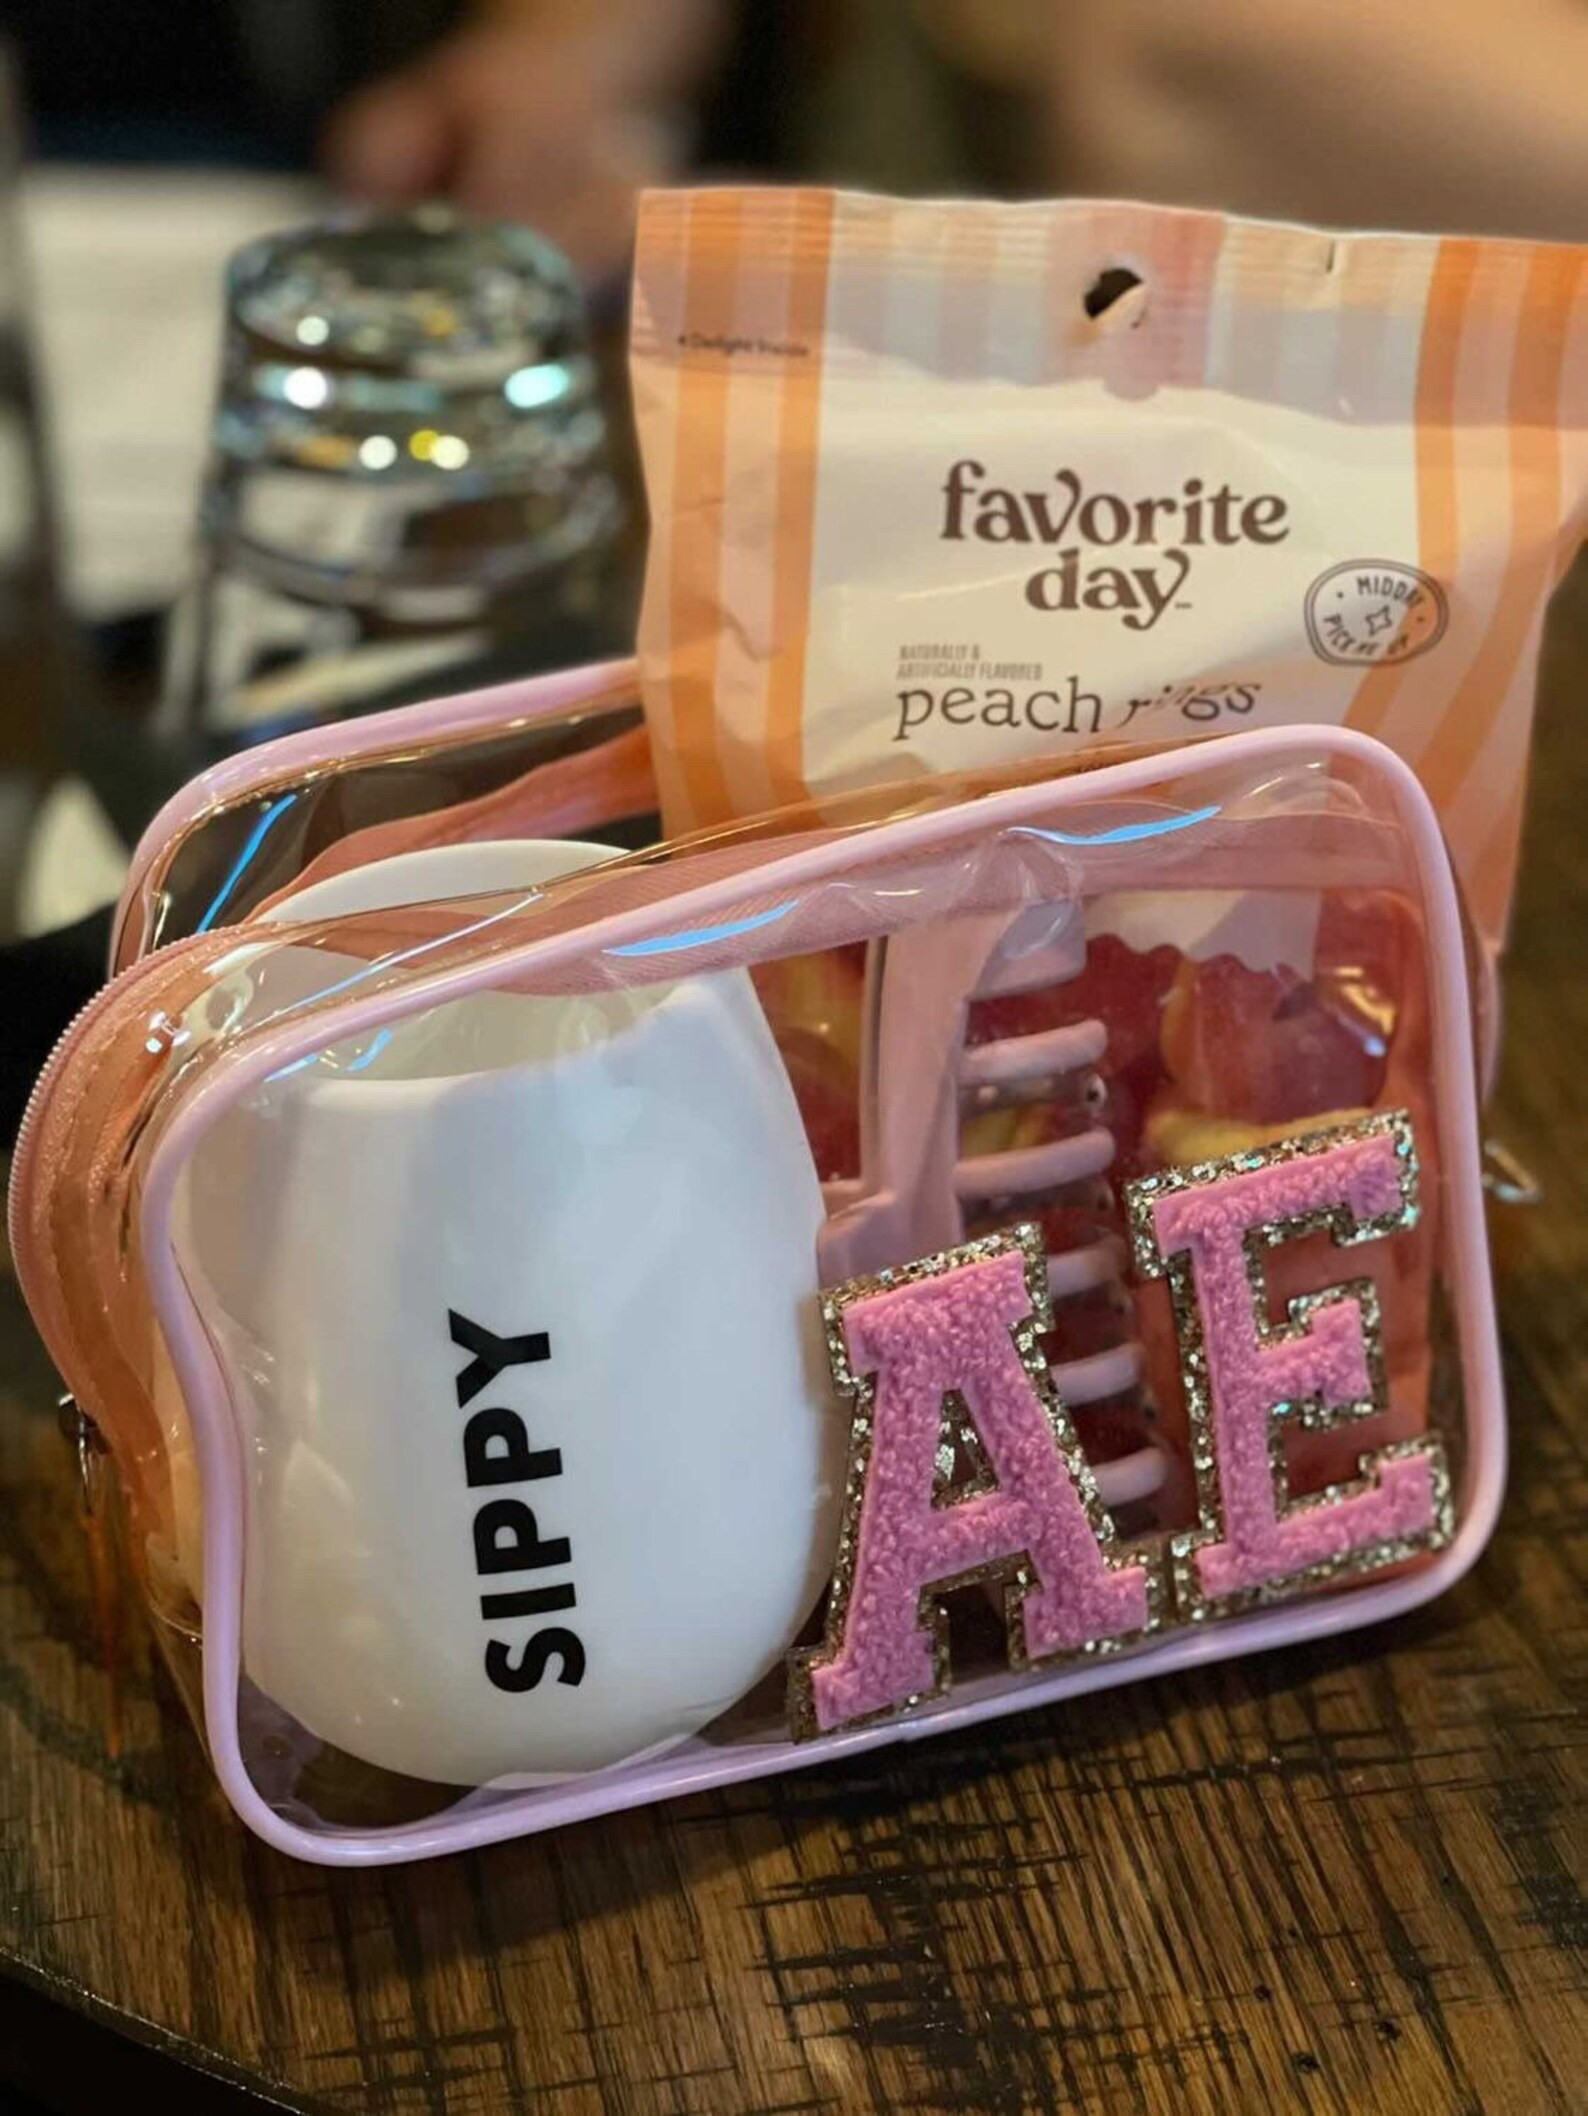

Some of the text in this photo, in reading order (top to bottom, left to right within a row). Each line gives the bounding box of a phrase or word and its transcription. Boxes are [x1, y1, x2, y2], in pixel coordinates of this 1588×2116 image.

[940, 459, 1290, 546] favorite
[1025, 547, 1190, 631] day
[896, 664, 976, 681] ARTIFICIALLY
[899, 645, 970, 661] NATURALLY
[892, 676, 1103, 742] peach
[447, 1307, 587, 1693] SIPPY
